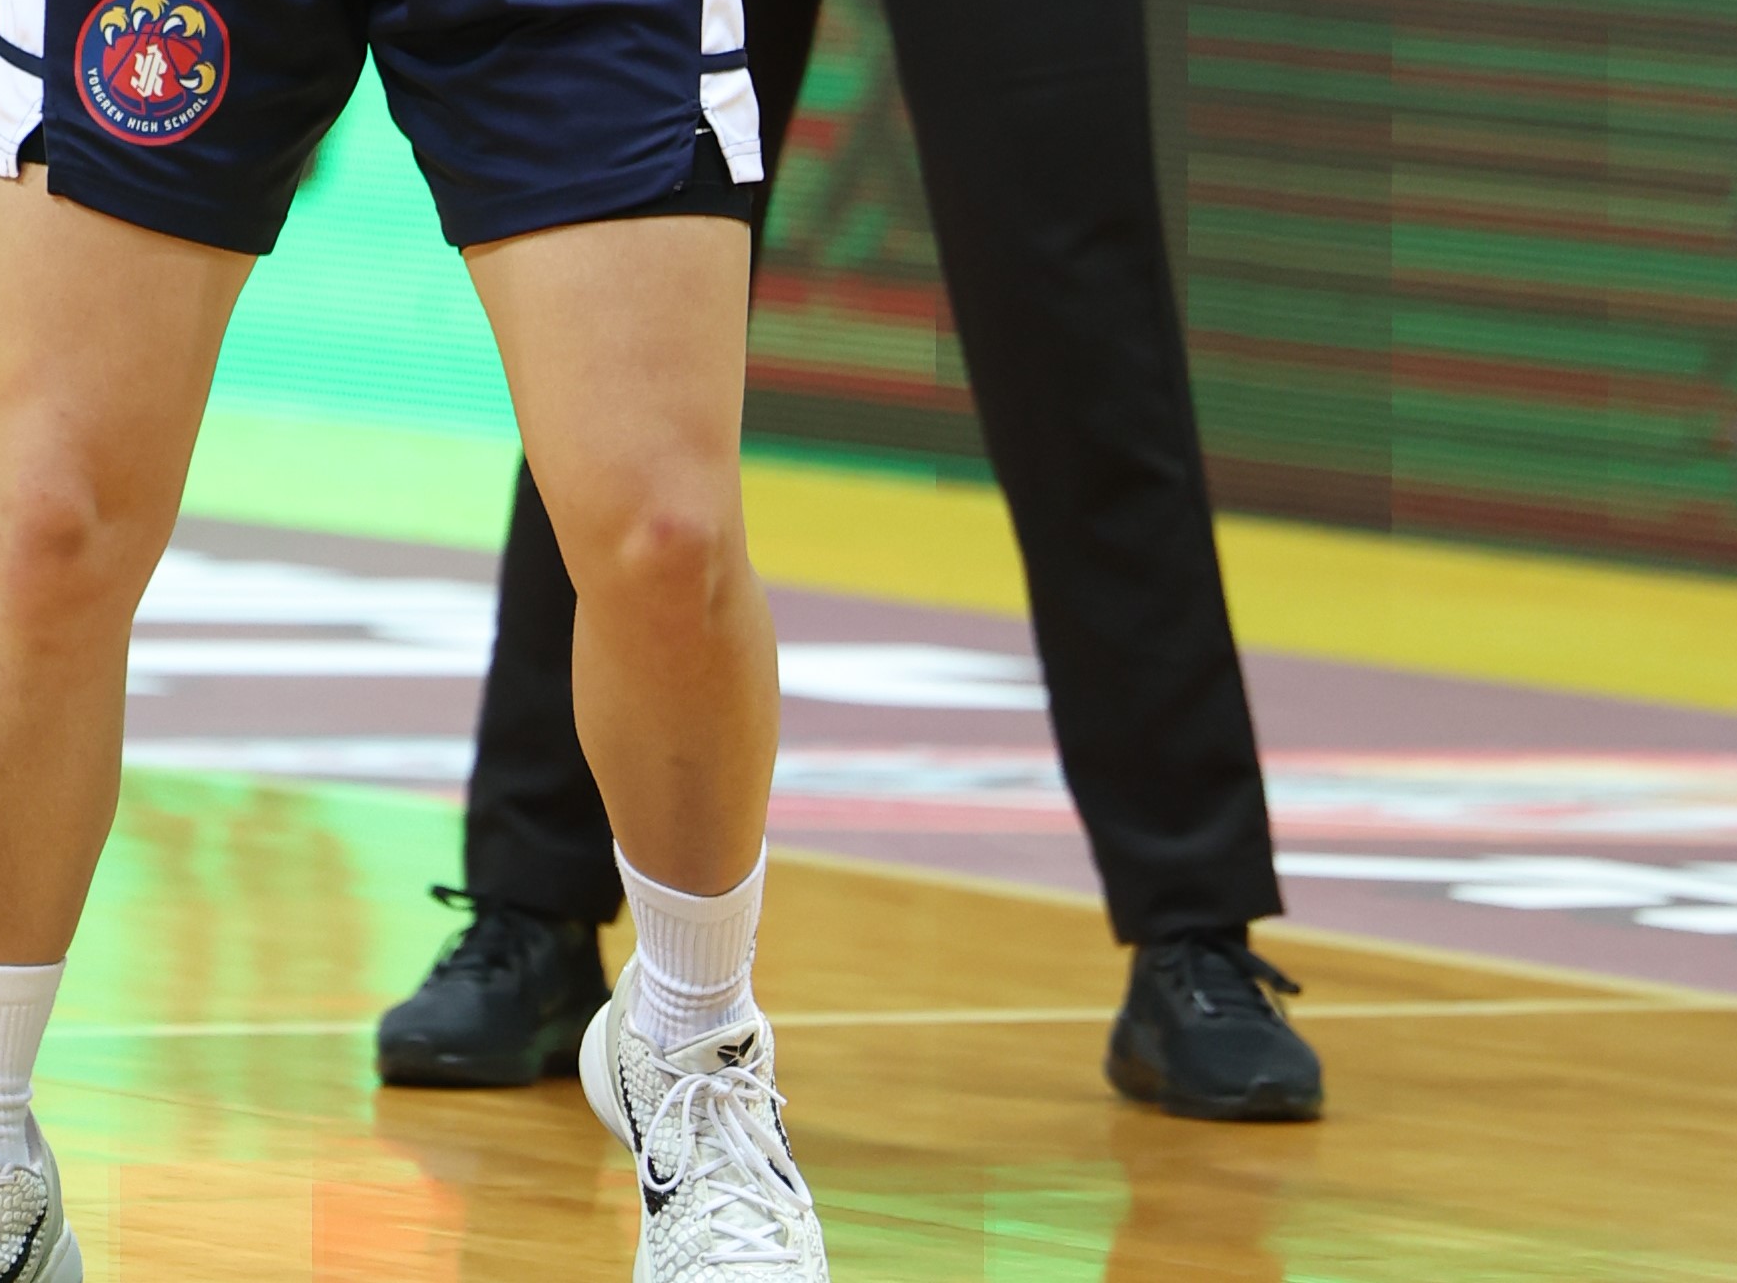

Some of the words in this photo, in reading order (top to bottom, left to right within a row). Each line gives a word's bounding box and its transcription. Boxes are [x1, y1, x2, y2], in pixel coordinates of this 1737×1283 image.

[87, 67, 125, 123] YONGREN
[126, 116, 159, 133] HIGH
[163, 97, 209, 132] SCHOOL
